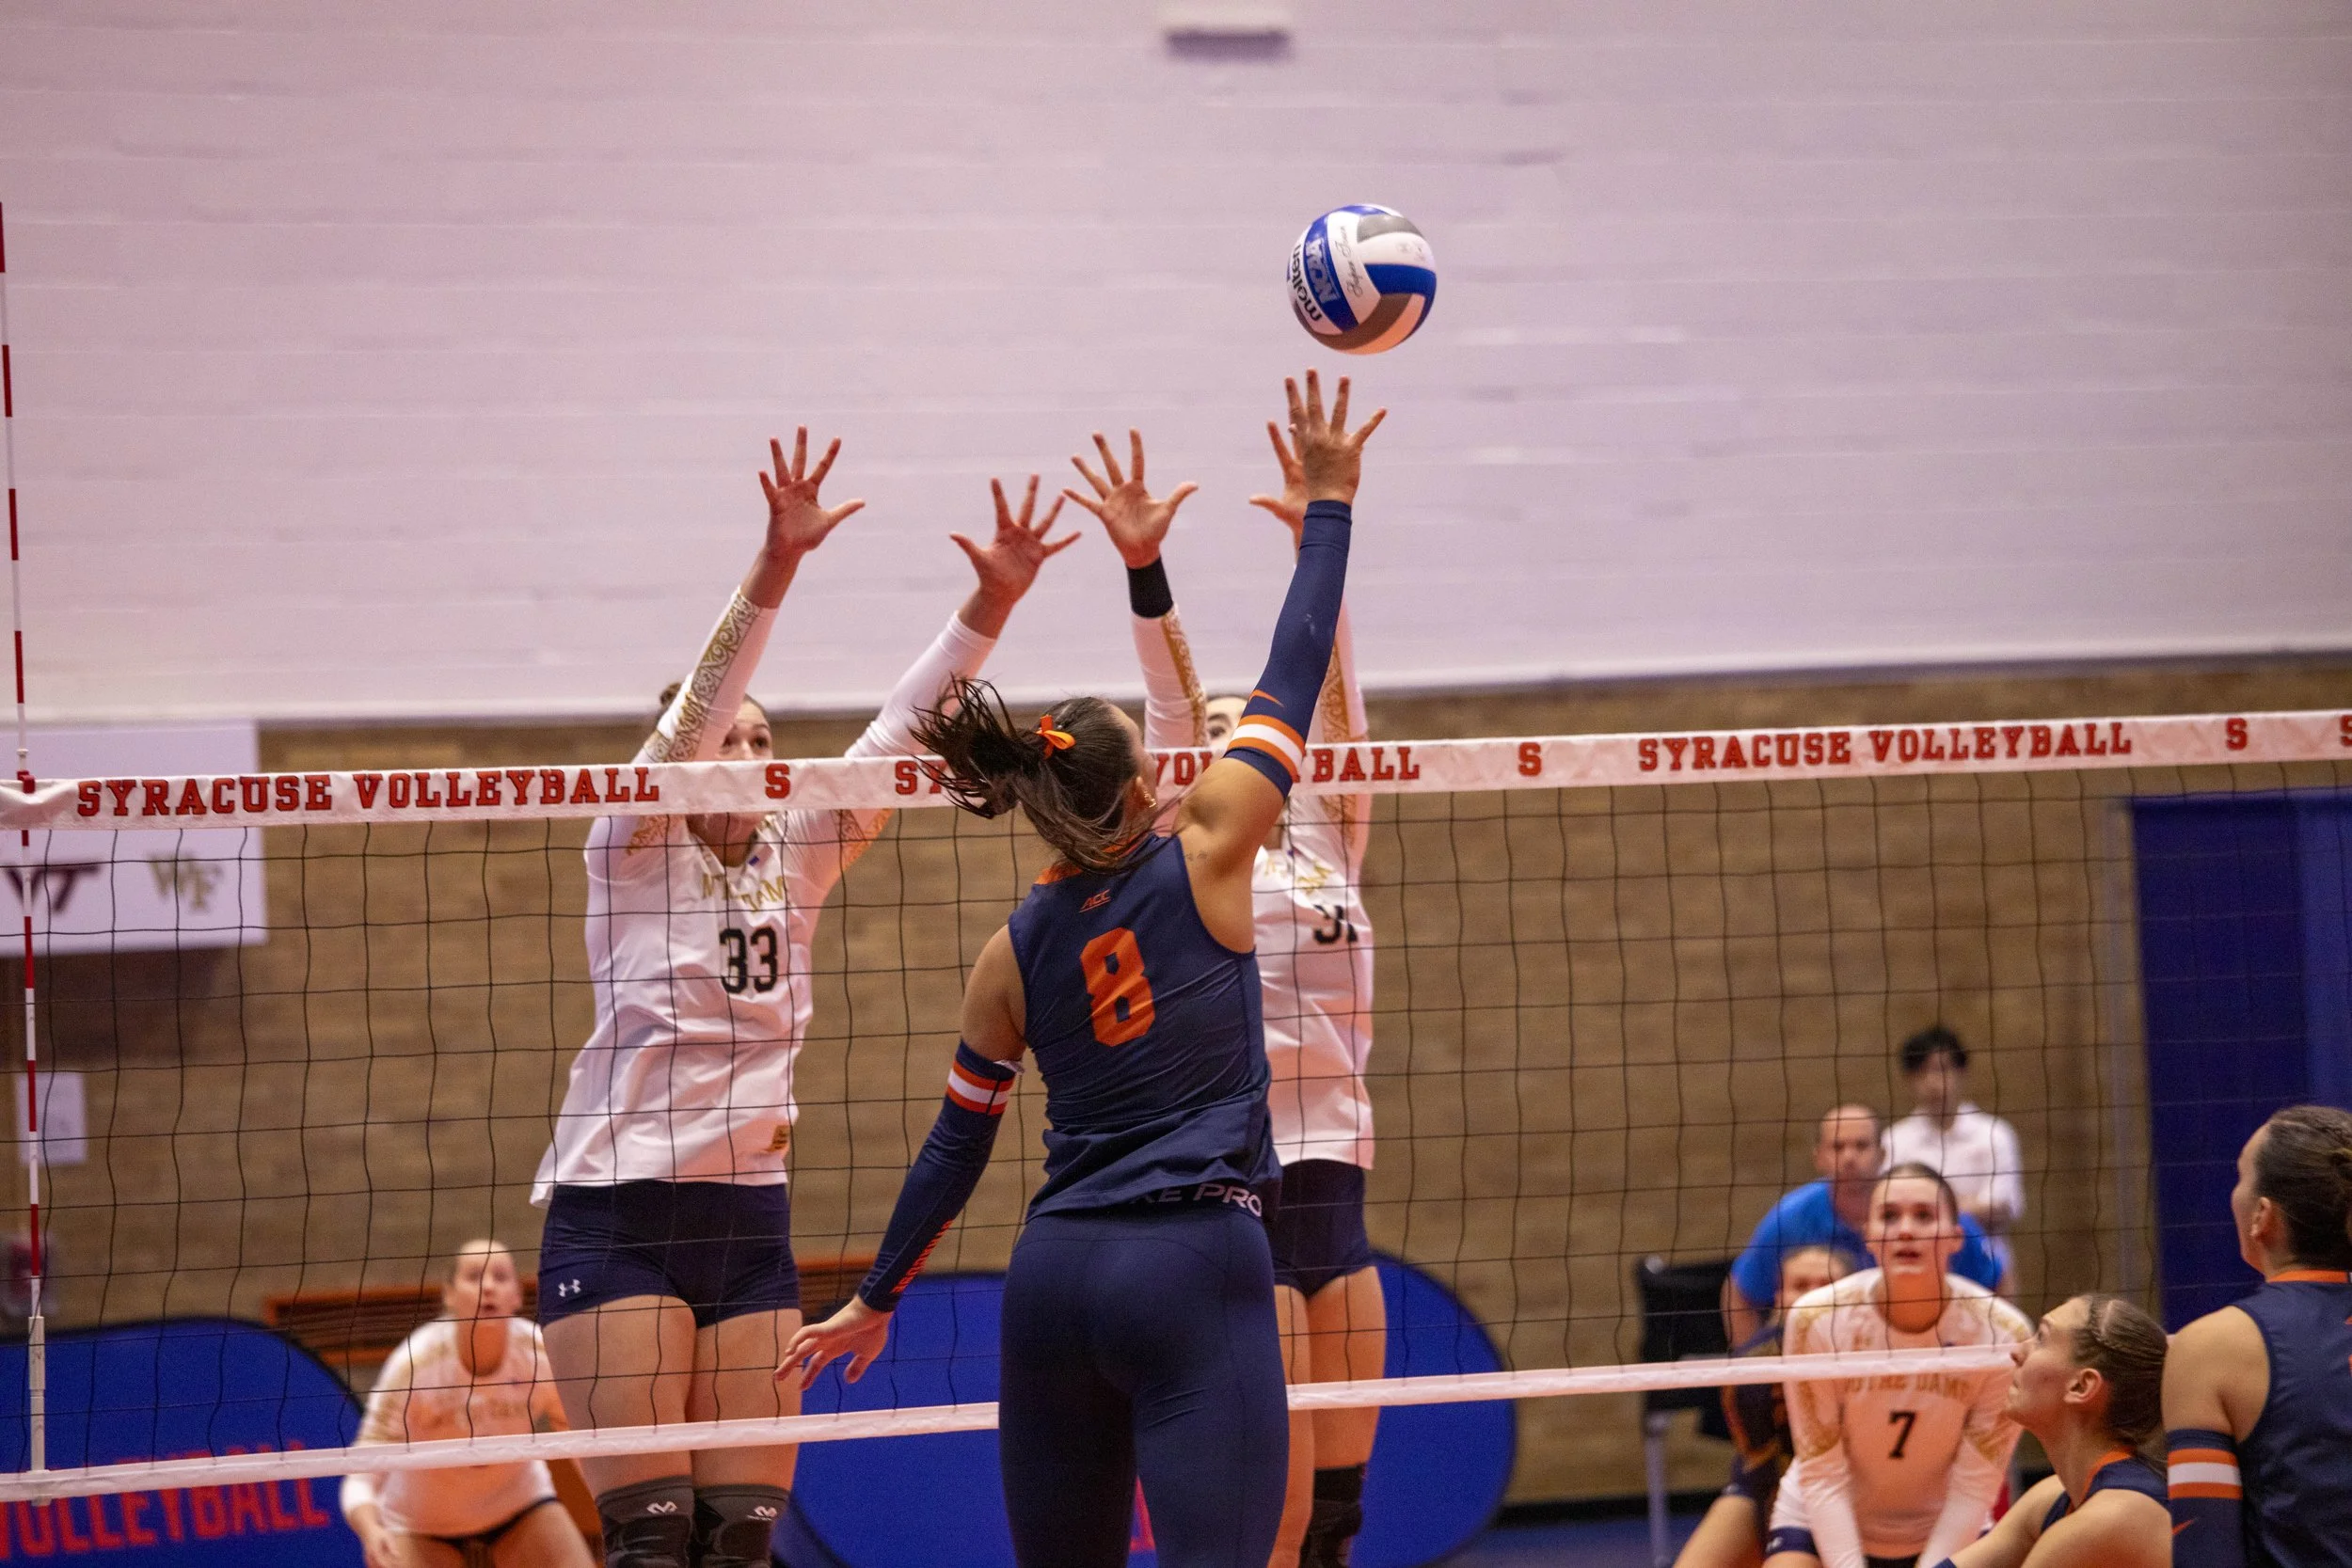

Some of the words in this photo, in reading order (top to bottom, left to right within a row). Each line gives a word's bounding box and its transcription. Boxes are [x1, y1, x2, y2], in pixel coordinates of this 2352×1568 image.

[1292, 245, 1323, 322] molten
[1306, 237, 1341, 303] NCAA
[1518, 742, 1543, 777] S
[1638, 732, 1851, 772] SYRACUSE
[1868, 721, 2132, 765] VOLLEYBALL
[2226, 718, 2248, 751] S
[77, 773, 332, 817] SYRACUSE
[353, 767, 660, 809] VOLLEYBALL
[765, 763, 790, 800] S
[720, 927, 777, 994] 33
[1080, 927, 1155, 1047] 8
[1192, 1182, 1263, 1217] PRO
[1889, 1410, 1916, 1460] 7
[0, 1442, 328, 1560] OLLEYBALL
